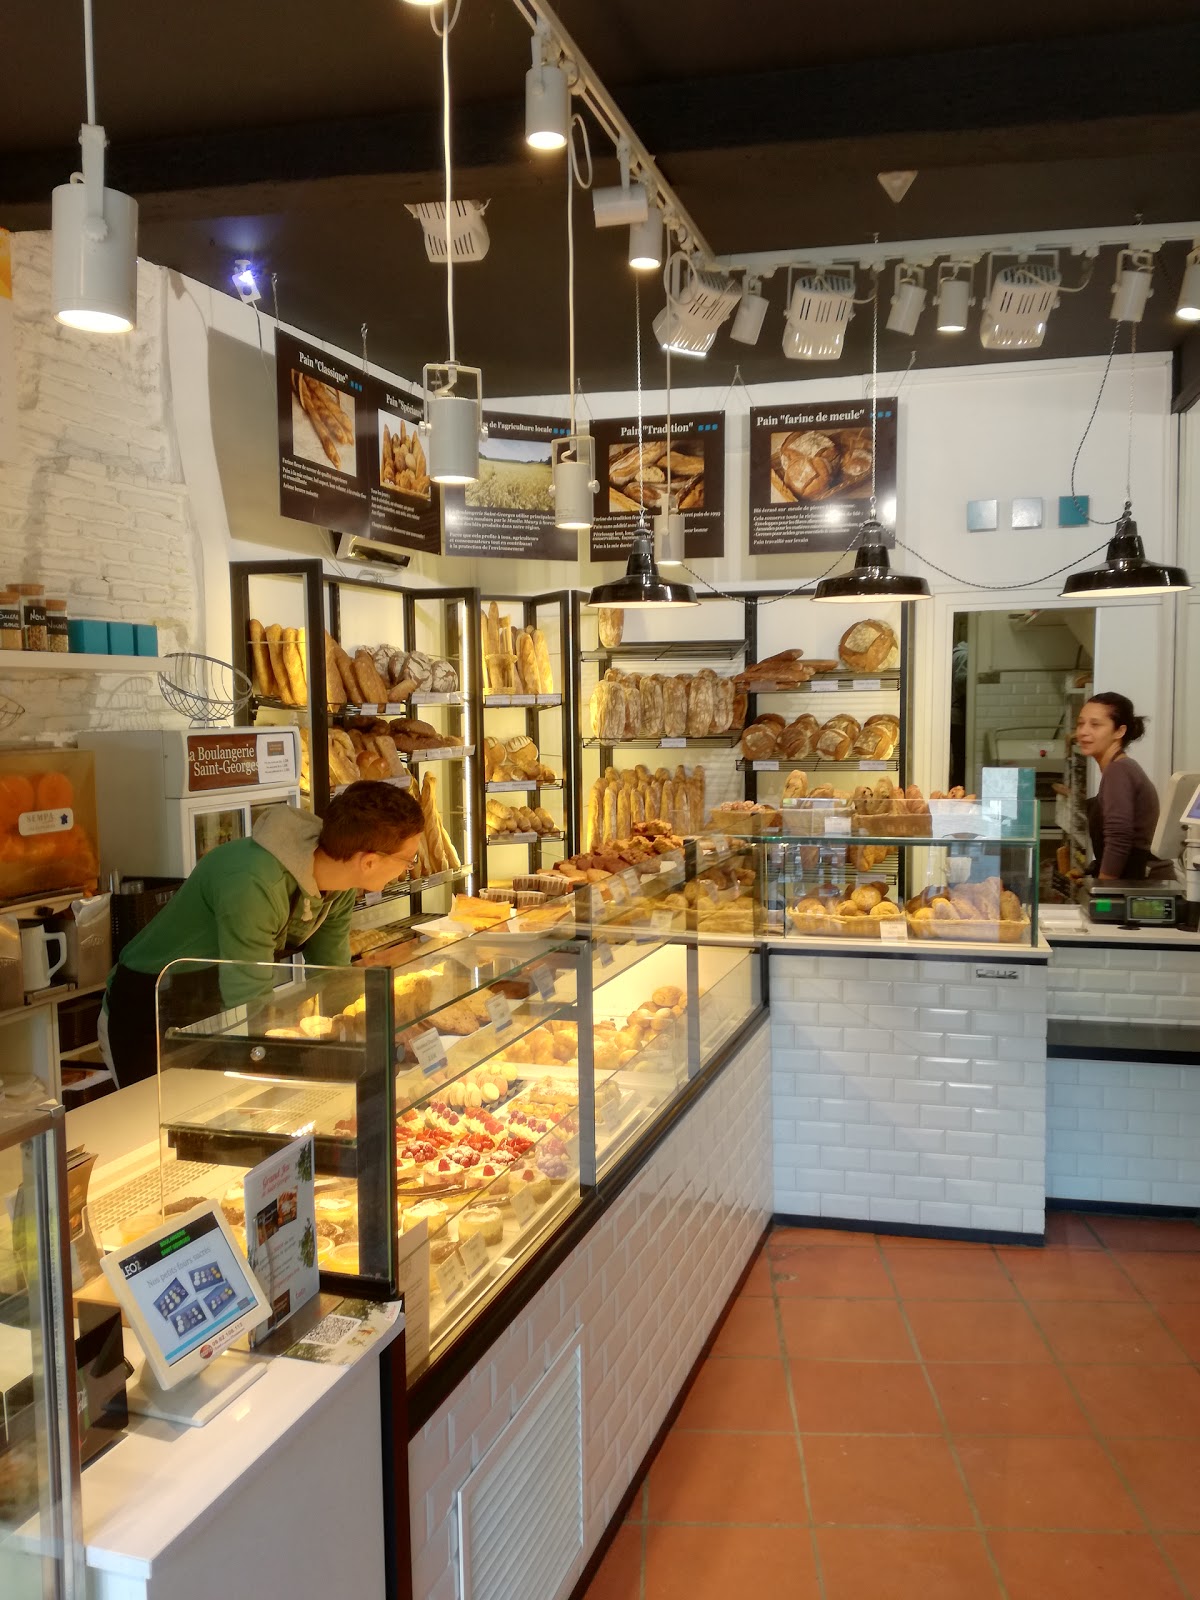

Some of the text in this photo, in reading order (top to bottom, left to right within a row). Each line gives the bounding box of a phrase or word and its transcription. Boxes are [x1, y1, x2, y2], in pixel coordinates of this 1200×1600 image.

[299, 351, 348, 383] Pain "Classique"
[386, 393, 398, 408] Pain
[756, 409, 865, 427] Pain "farine de meule"
[498, 422, 534, 432] l'agriculture
[535, 424, 552, 434] locale
[620, 422, 694, 437] Pain "Tradtion"
[198, 744, 254, 762] Boulangerie
[194, 760, 258, 776] Saint-Georges
[160, 1266, 177, 1283] petits
[177, 1258, 193, 1273] fours
[192, 1246, 212, 1262] sucrés
